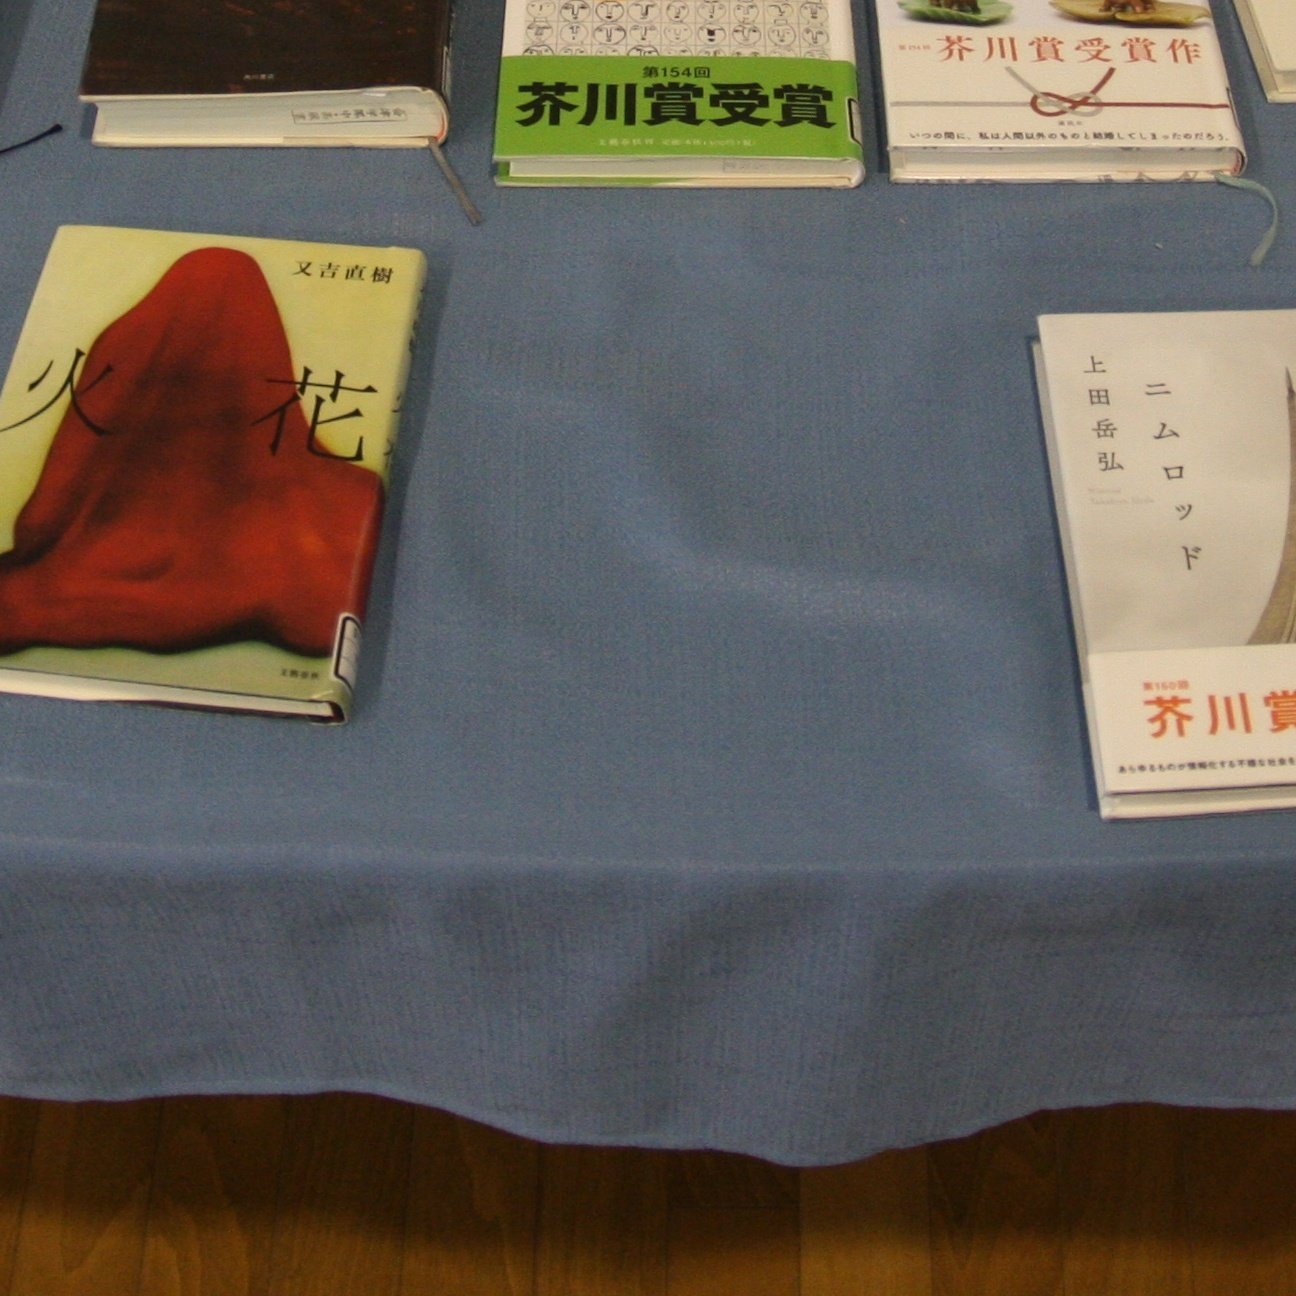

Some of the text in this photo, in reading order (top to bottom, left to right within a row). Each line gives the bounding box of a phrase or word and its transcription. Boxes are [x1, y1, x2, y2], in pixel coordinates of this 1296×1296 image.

[937, 35, 1201, 65] 芥川賞受賞作
[642, 66, 711, 79] 第154回
[516, 81, 837, 130] 芥川賞受賞
[293, 261, 393, 284] 又吉直樹
[1084, 356, 1125, 472] 上田岳弘
[1145, 381, 1202, 571] ニムロッド
